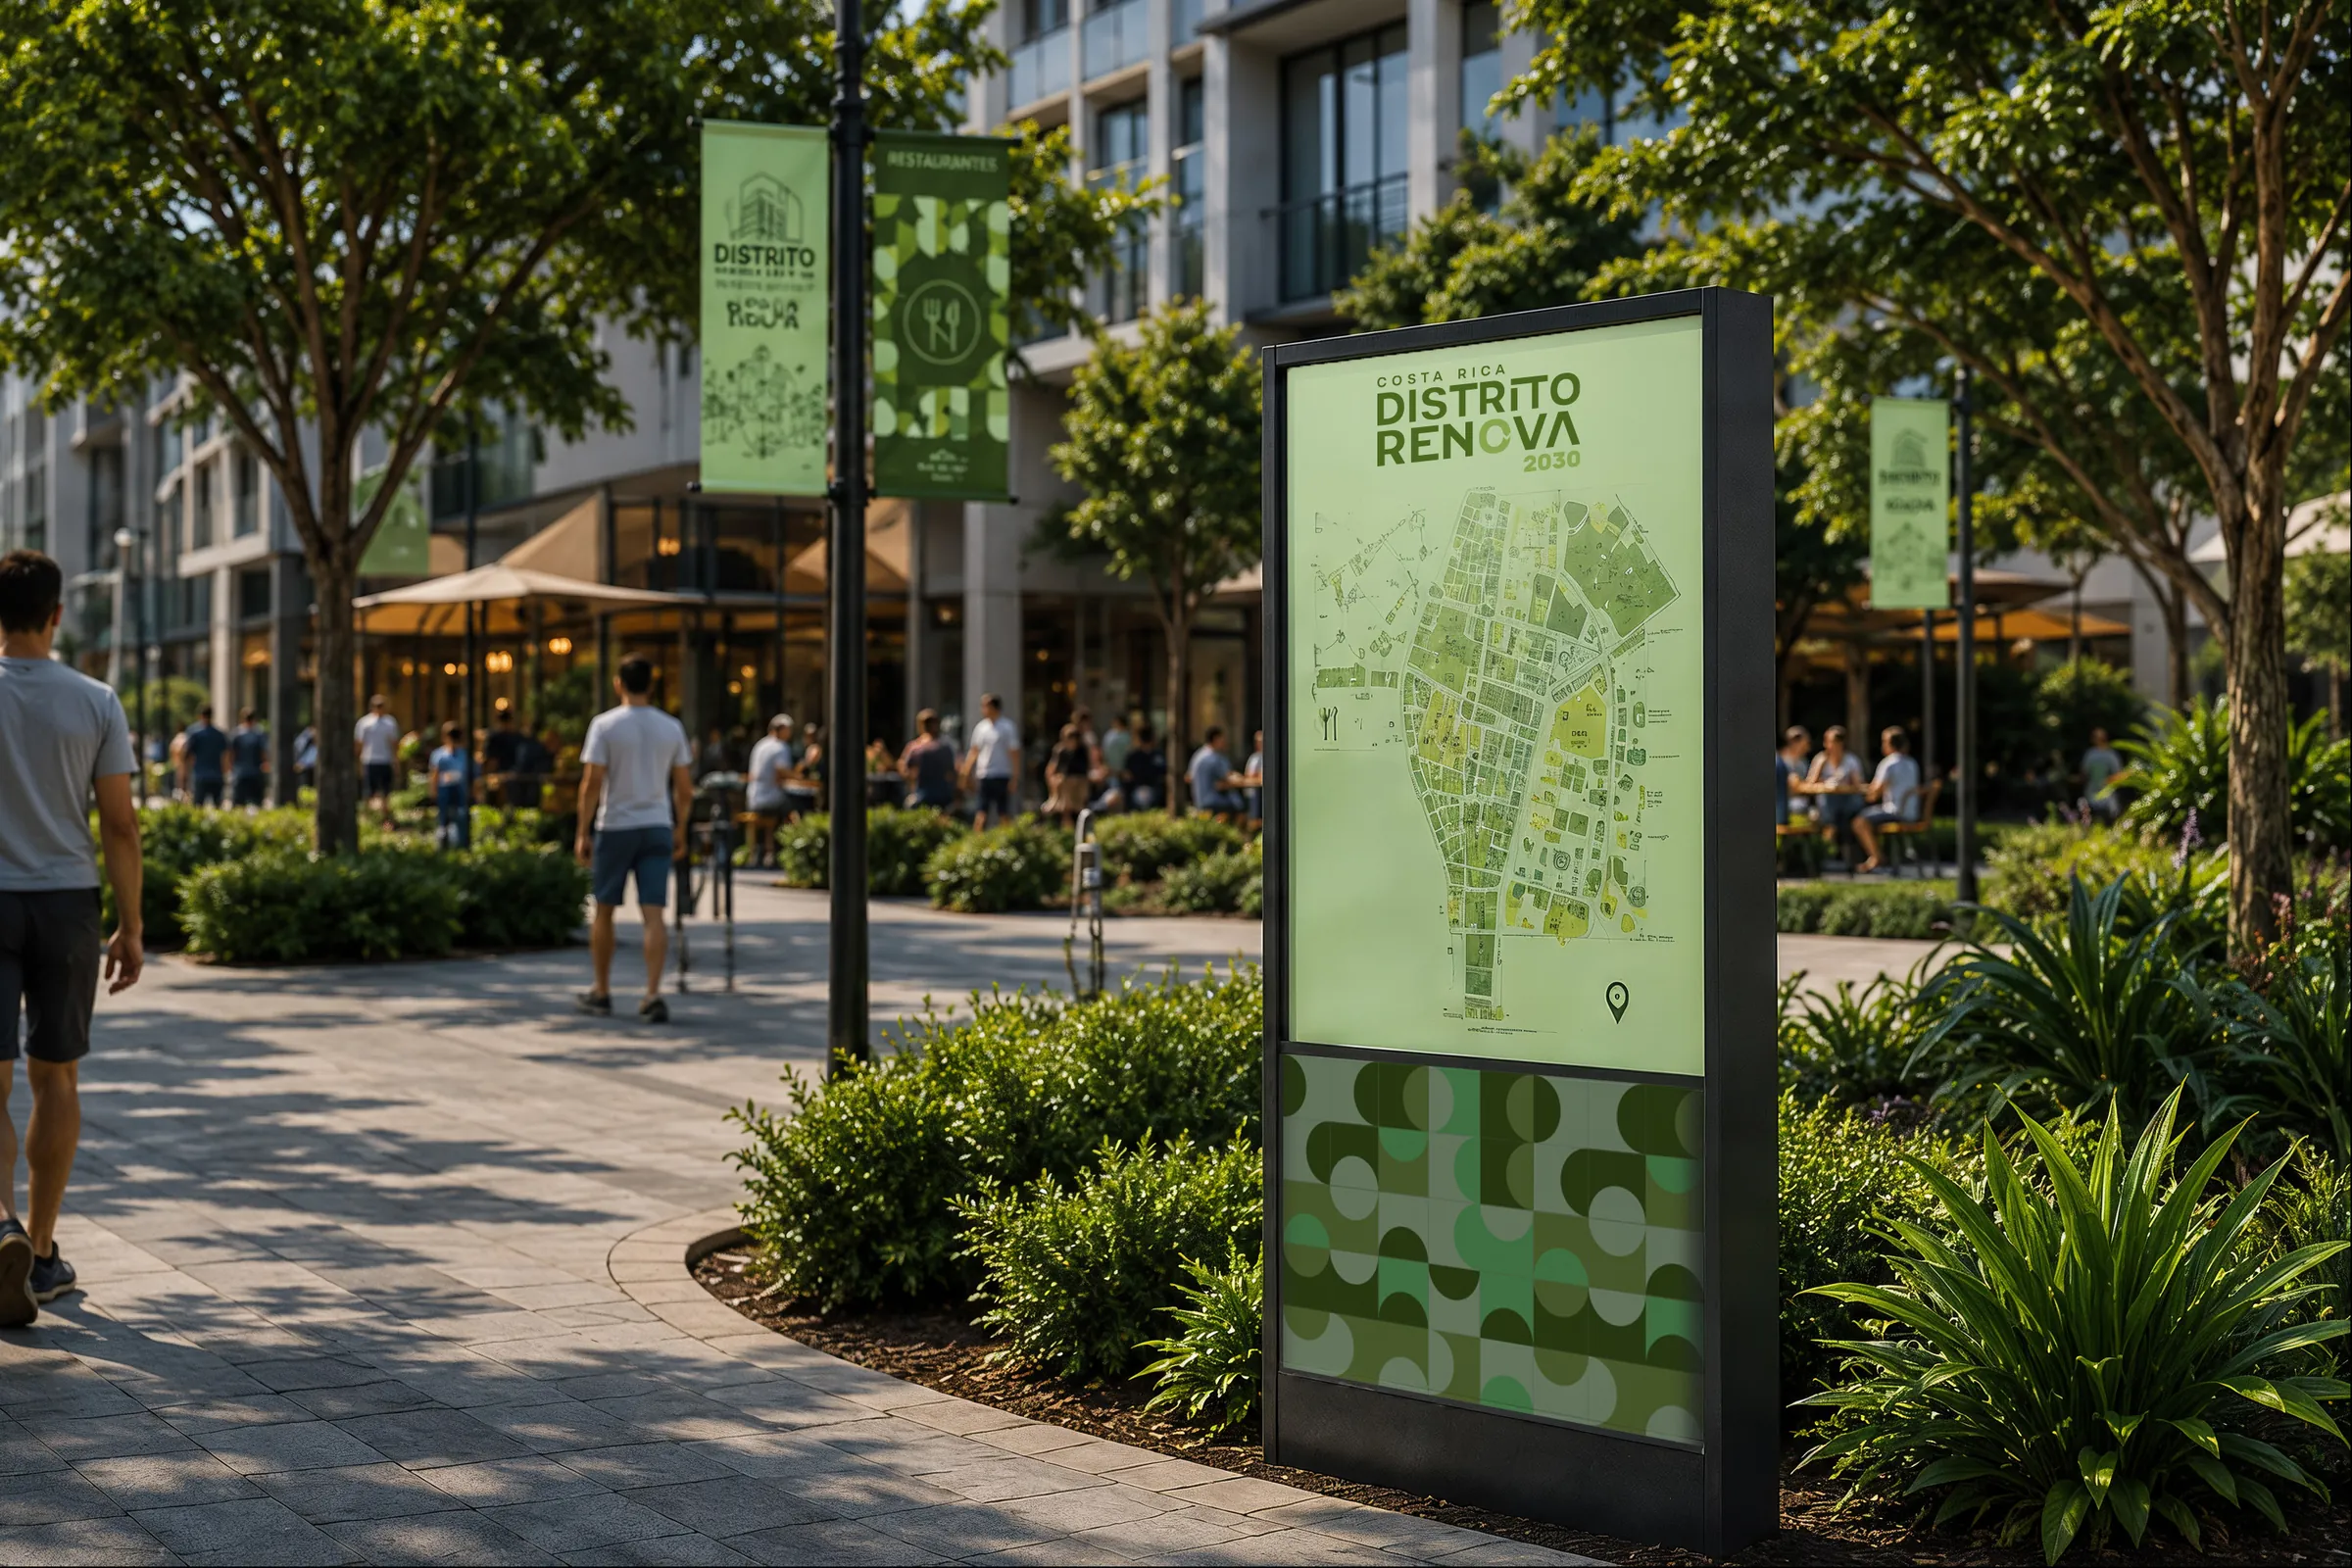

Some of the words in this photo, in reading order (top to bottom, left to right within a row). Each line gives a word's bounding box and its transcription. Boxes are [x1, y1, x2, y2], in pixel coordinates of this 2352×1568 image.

[887, 151, 998, 172] RESTAURANTES
[714, 243, 815, 268] DISTRITO
[1377, 370, 1443, 388] COSTA
[1457, 364, 1505, 379] RICA
[1377, 372, 1581, 426] DISTRITO
[1377, 411, 1581, 467] RENOVA
[1523, 450, 1581, 473] 2030
